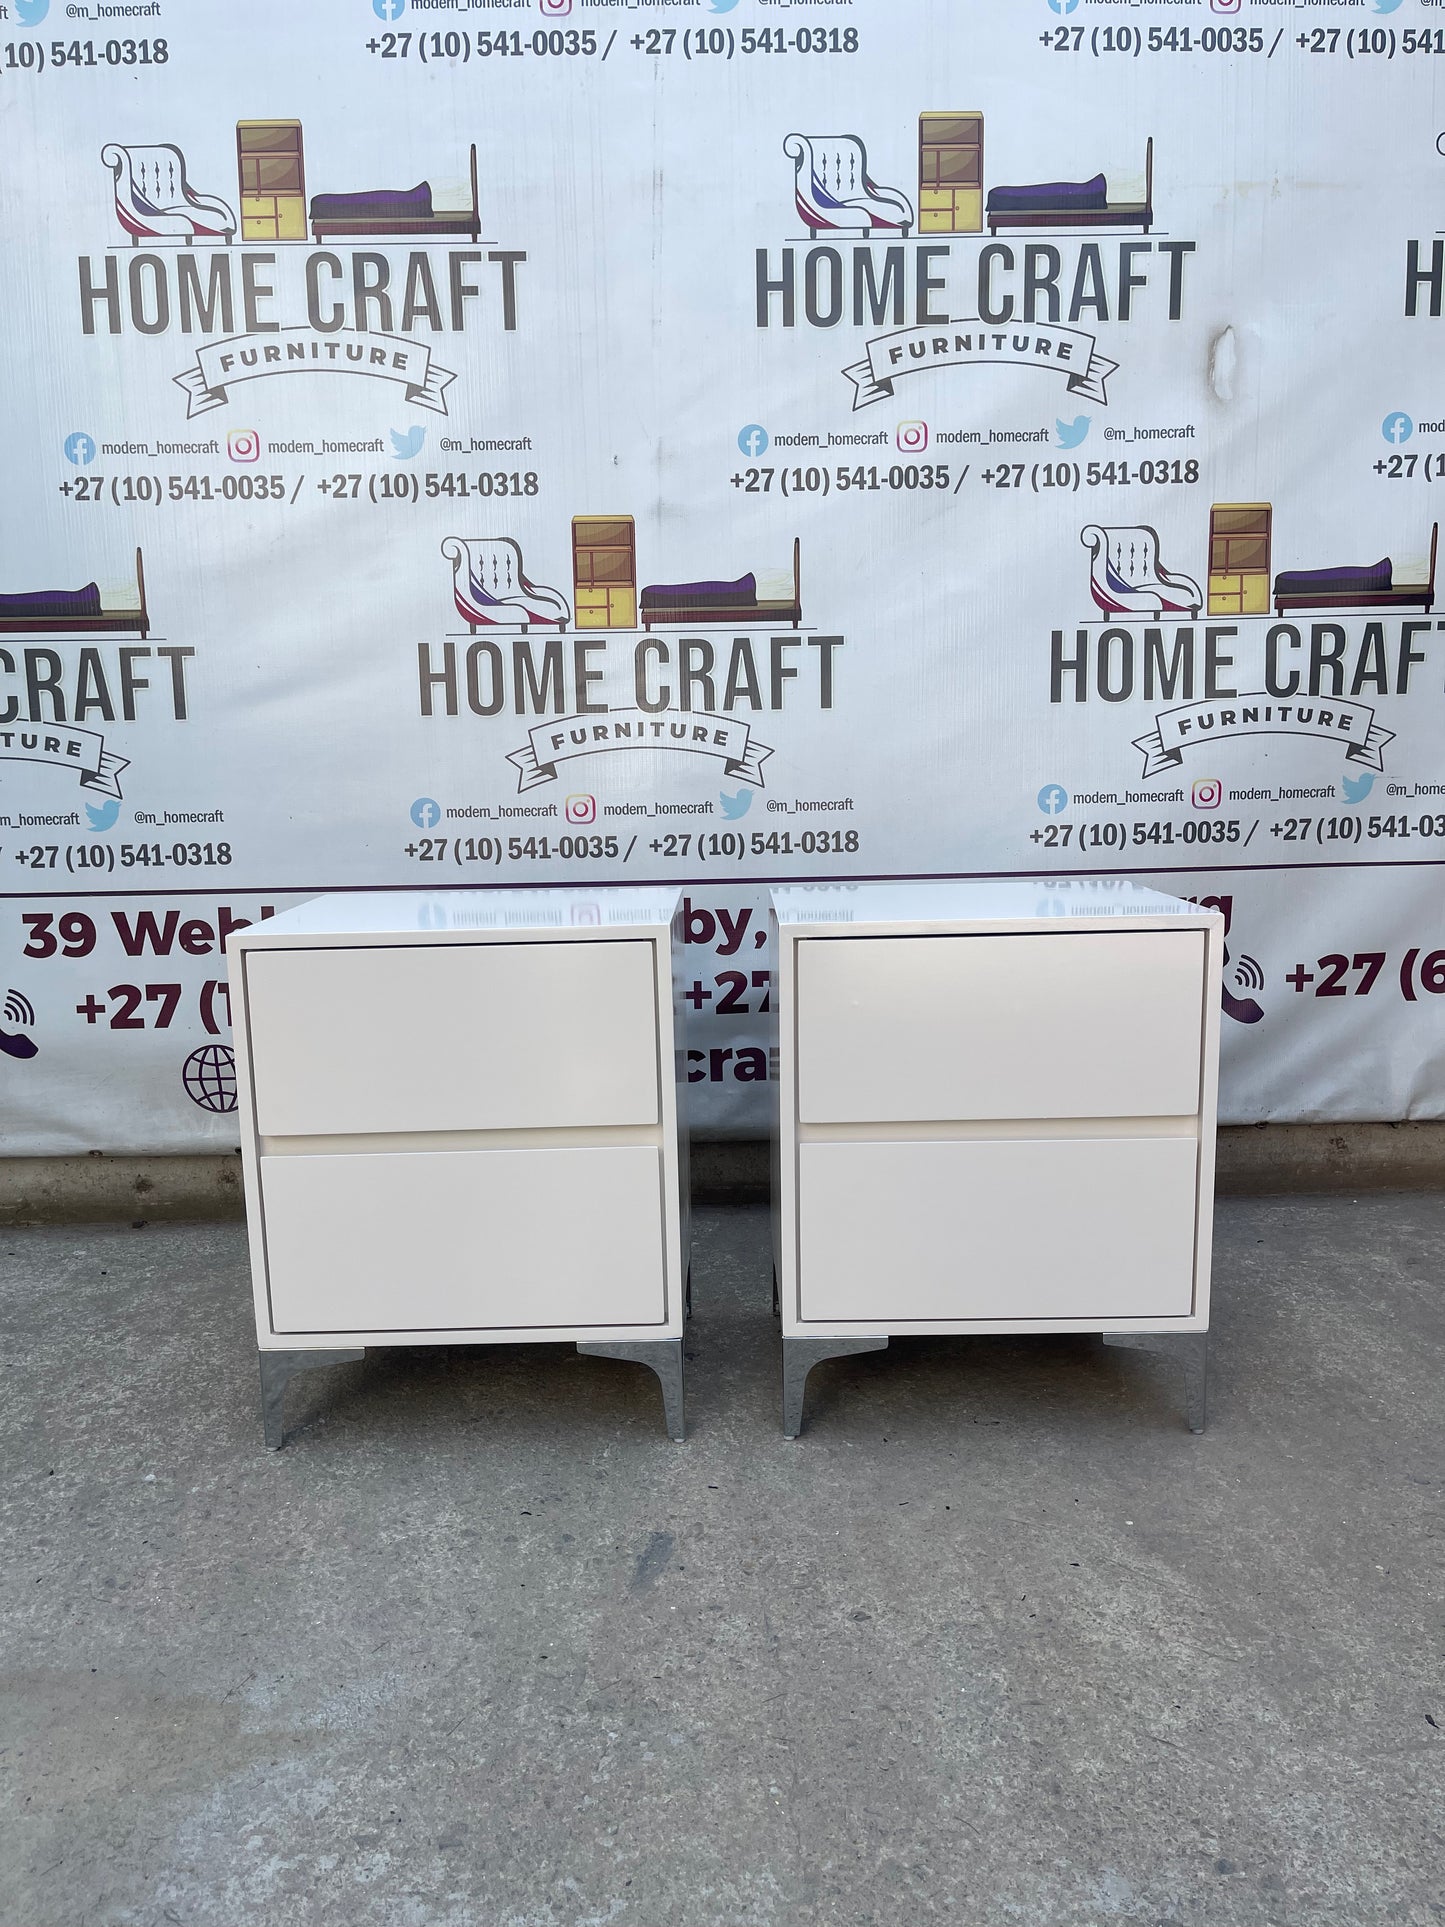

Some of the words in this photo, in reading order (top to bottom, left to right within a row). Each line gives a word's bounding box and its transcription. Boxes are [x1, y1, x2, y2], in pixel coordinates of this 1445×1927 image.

[66, 2, 161, 20] @m_homecraft
[0, 42, 45, 74] 10)
[51, 39, 168, 66] 541-0318
[366, 33, 412, 58] +27
[419, 32, 470, 63] (10)
[477, 30, 596, 56] 541-0035
[630, 29, 676, 54] +27
[684, 28, 734, 60] (10)
[741, 28, 858, 53] 541-0318
[1039, 26, 1084, 51] +27
[1092, 27, 1141, 57] (10)
[1148, 27, 1263, 52] 541-0035
[1296, 28, 1340, 53] +27
[1347, 29, 1395, 59] (10)
[1402, 29, 1445, 54] 541
[78, 253, 280, 335] HOME
[305, 250, 528, 333] CRAFT
[755, 242, 952, 328] HOME
[977, 240, 1197, 325] CRAFT
[1404, 239, 1445, 317] H
[219, 341, 410, 374] FURNITURE
[888, 333, 1074, 366] FURNITURE
[440, 437, 532, 453] @m_homecraft
[1104, 425, 1195, 442] @m_homecraft
[730, 468, 774, 492] +27
[781, 468, 829, 497] (10)
[836, 465, 949, 490] 541-0035
[981, 464, 1025, 488] +27
[1032, 463, 1080, 492] (10)
[1086, 459, 1199, 486] 541-0318
[1373, 454, 1418, 478] +27
[59, 477, 104, 500] +27
[112, 476, 162, 506] (10)
[169, 475, 285, 500] 541-0035
[318, 474, 361, 498] +27
[369, 474, 418, 503] (10)
[425, 472, 538, 497] 541-0318
[418, 640, 608, 719] HOME
[634, 634, 845, 713] CRAFT
[1050, 626, 1239, 704] HOME
[1264, 620, 1445, 699] CRAF
[551, 723, 731, 751] FURNITURE
[1177, 706, 1354, 736] FURNITURE
[135, 810, 224, 826] @m_homecraft
[767, 798, 854, 814] @m_homecraft
[405, 839, 447, 861] +27
[454, 838, 502, 865] (10)
[508, 836, 618, 859] 541-0035
[649, 834, 691, 856] +27
[698, 833, 745, 861] (10)
[751, 830, 859, 855] 541-0318
[1030, 825, 1073, 847] +27
[1079, 823, 1126, 851] (10)
[1132, 820, 1240, 845] 541-0035
[1270, 818, 1312, 840] +27
[1317, 817, 1361, 844] (10)
[15, 846, 58, 868] +27
[66, 845, 114, 873] (10)
[121, 843, 232, 867] 541-0318
[22, 912, 96, 958] 39
[1286, 952, 1386, 997] +27
[76, 984, 181, 1029] +27
